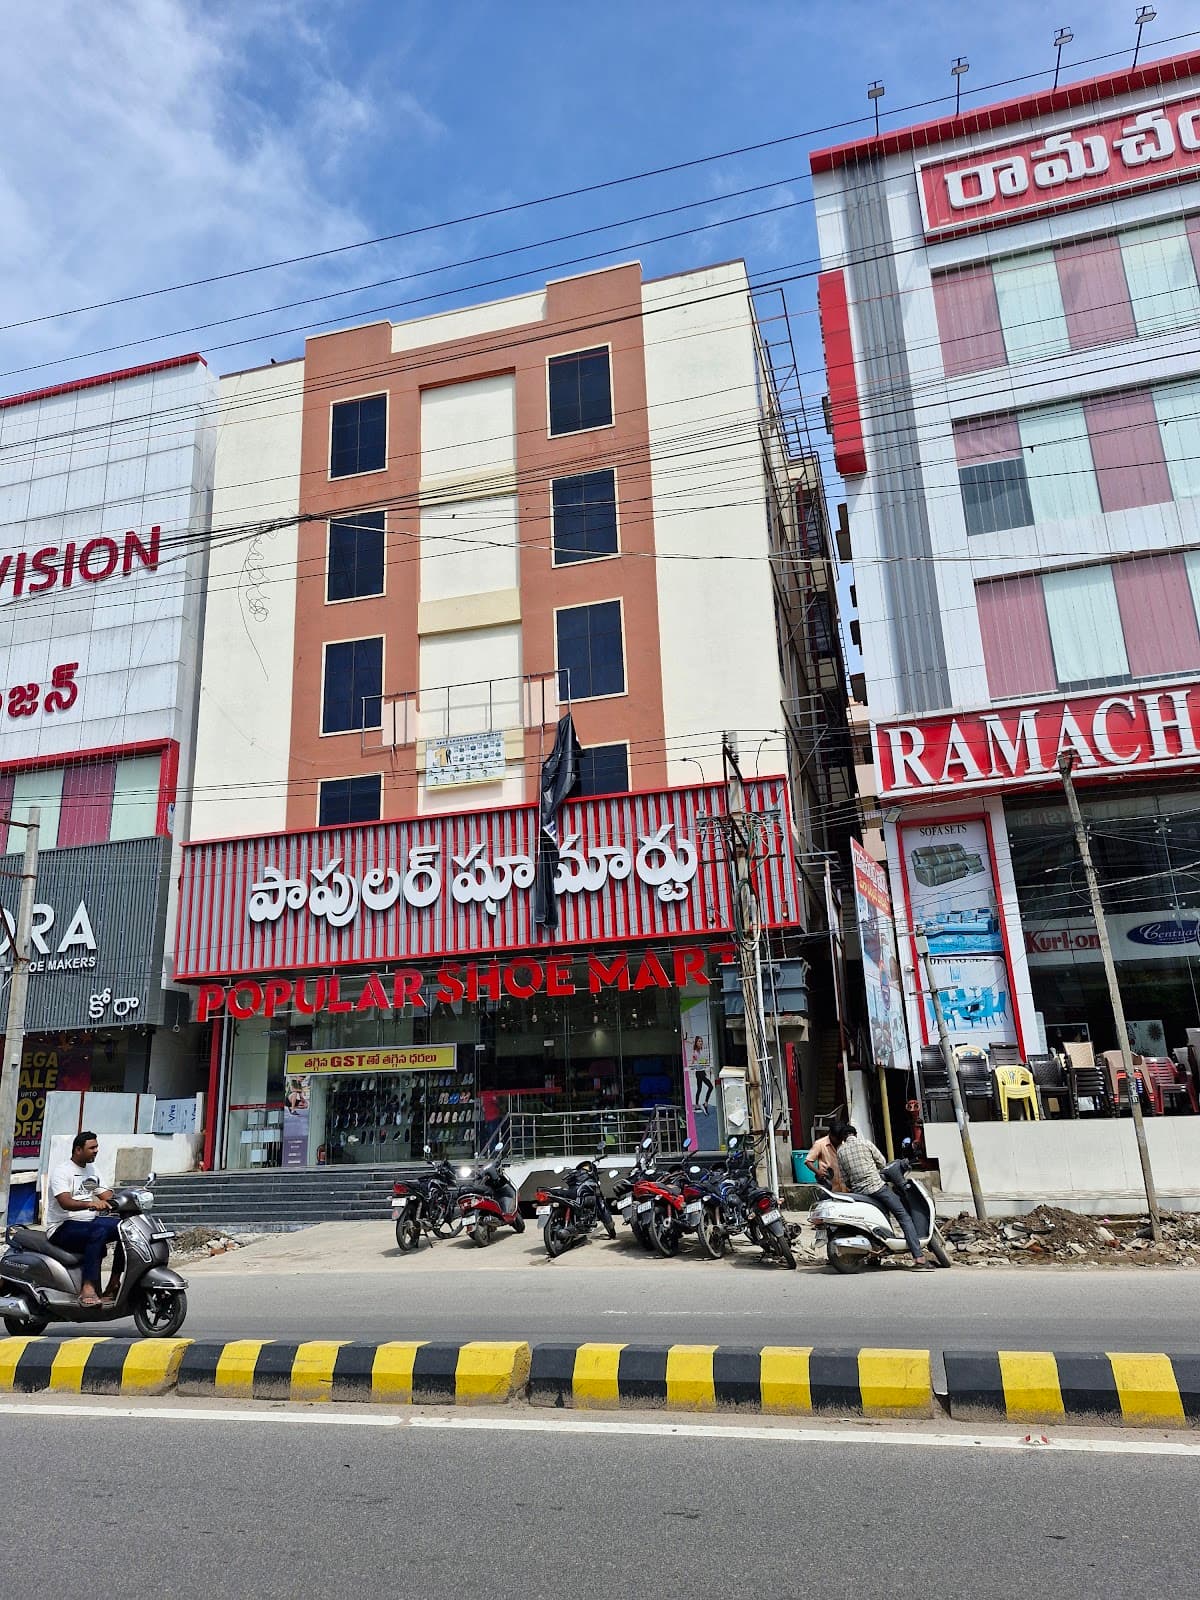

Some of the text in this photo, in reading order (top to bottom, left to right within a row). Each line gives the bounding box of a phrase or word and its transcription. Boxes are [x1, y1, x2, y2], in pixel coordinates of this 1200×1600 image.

[919, 823, 968, 837] SOFA SETS
[249, 844, 442, 927] పాపులర్
[47, 956, 96, 971] MAKERS
[196, 967, 428, 1022] POPULAR
[436, 952, 577, 1004] SHOE
[88, 987, 140, 1019] కోరా
[22, 1051, 58, 1069] EGA
[330, 1055, 366, 1068] GST
[19, 1069, 58, 1089] ALE
